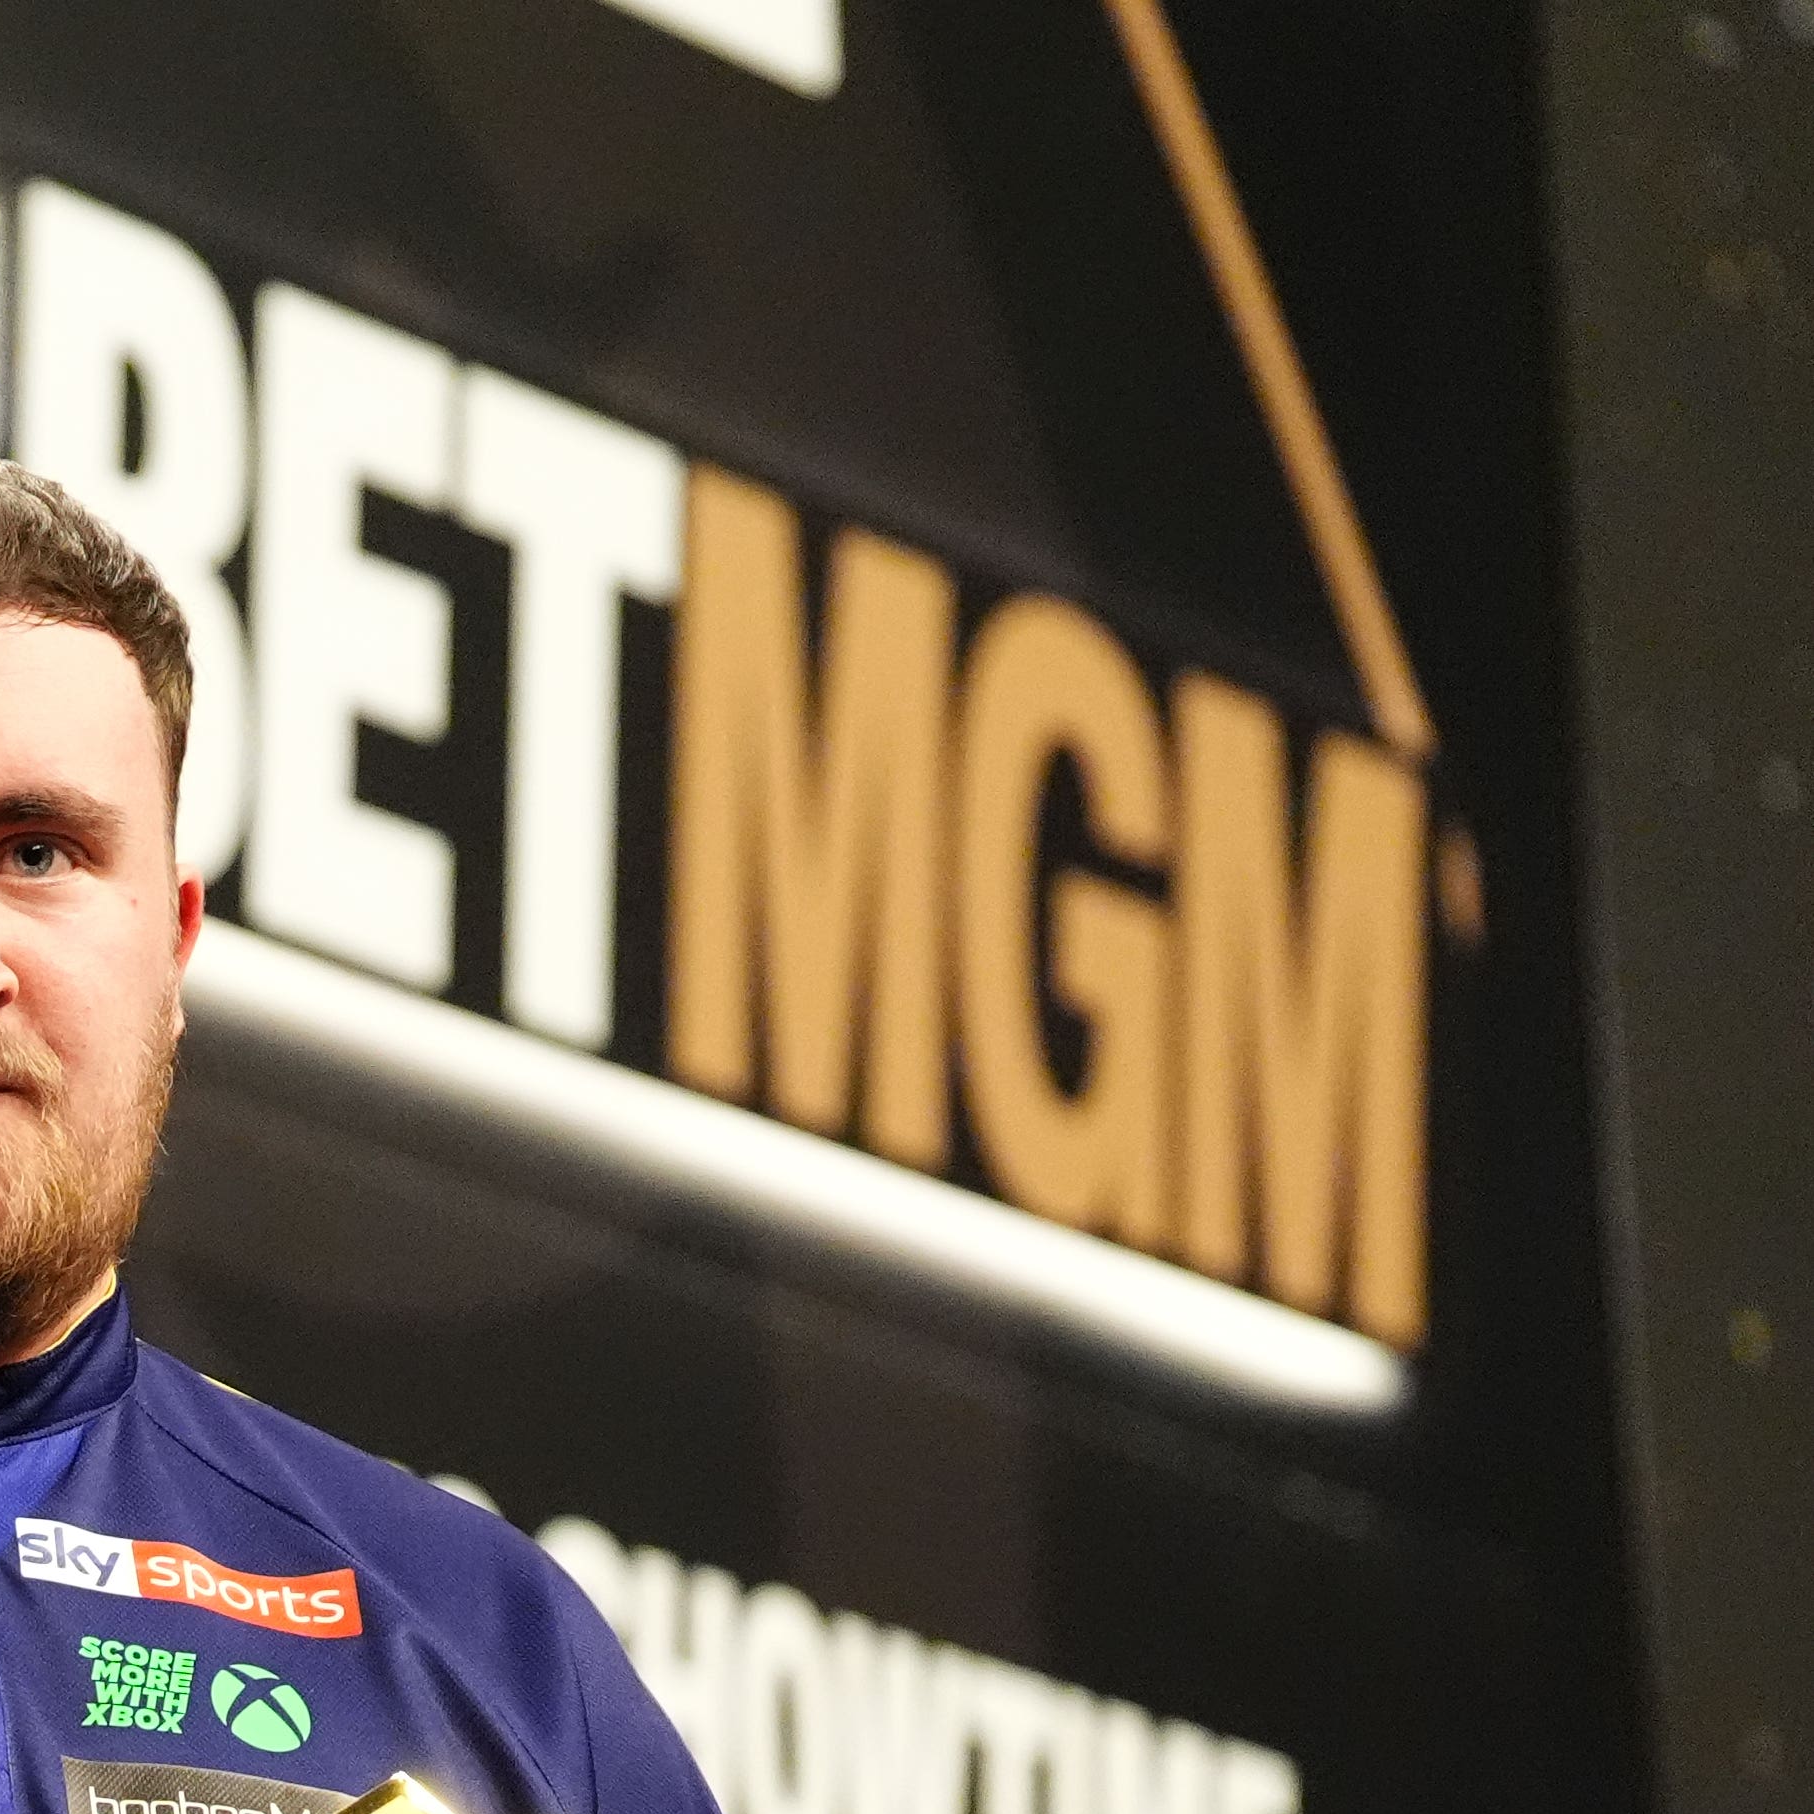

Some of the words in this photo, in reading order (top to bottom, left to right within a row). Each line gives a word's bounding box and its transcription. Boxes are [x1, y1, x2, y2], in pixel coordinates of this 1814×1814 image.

[16, 175, 1429, 1354] BETMGM
[17, 1527, 121, 1588] sky
[147, 1556, 346, 1624] sports
[78, 1636, 197, 1674] SCORE
[91, 1659, 194, 1694] MORE
[95, 1681, 190, 1714] WITH
[80, 1702, 186, 1735] XBOX
